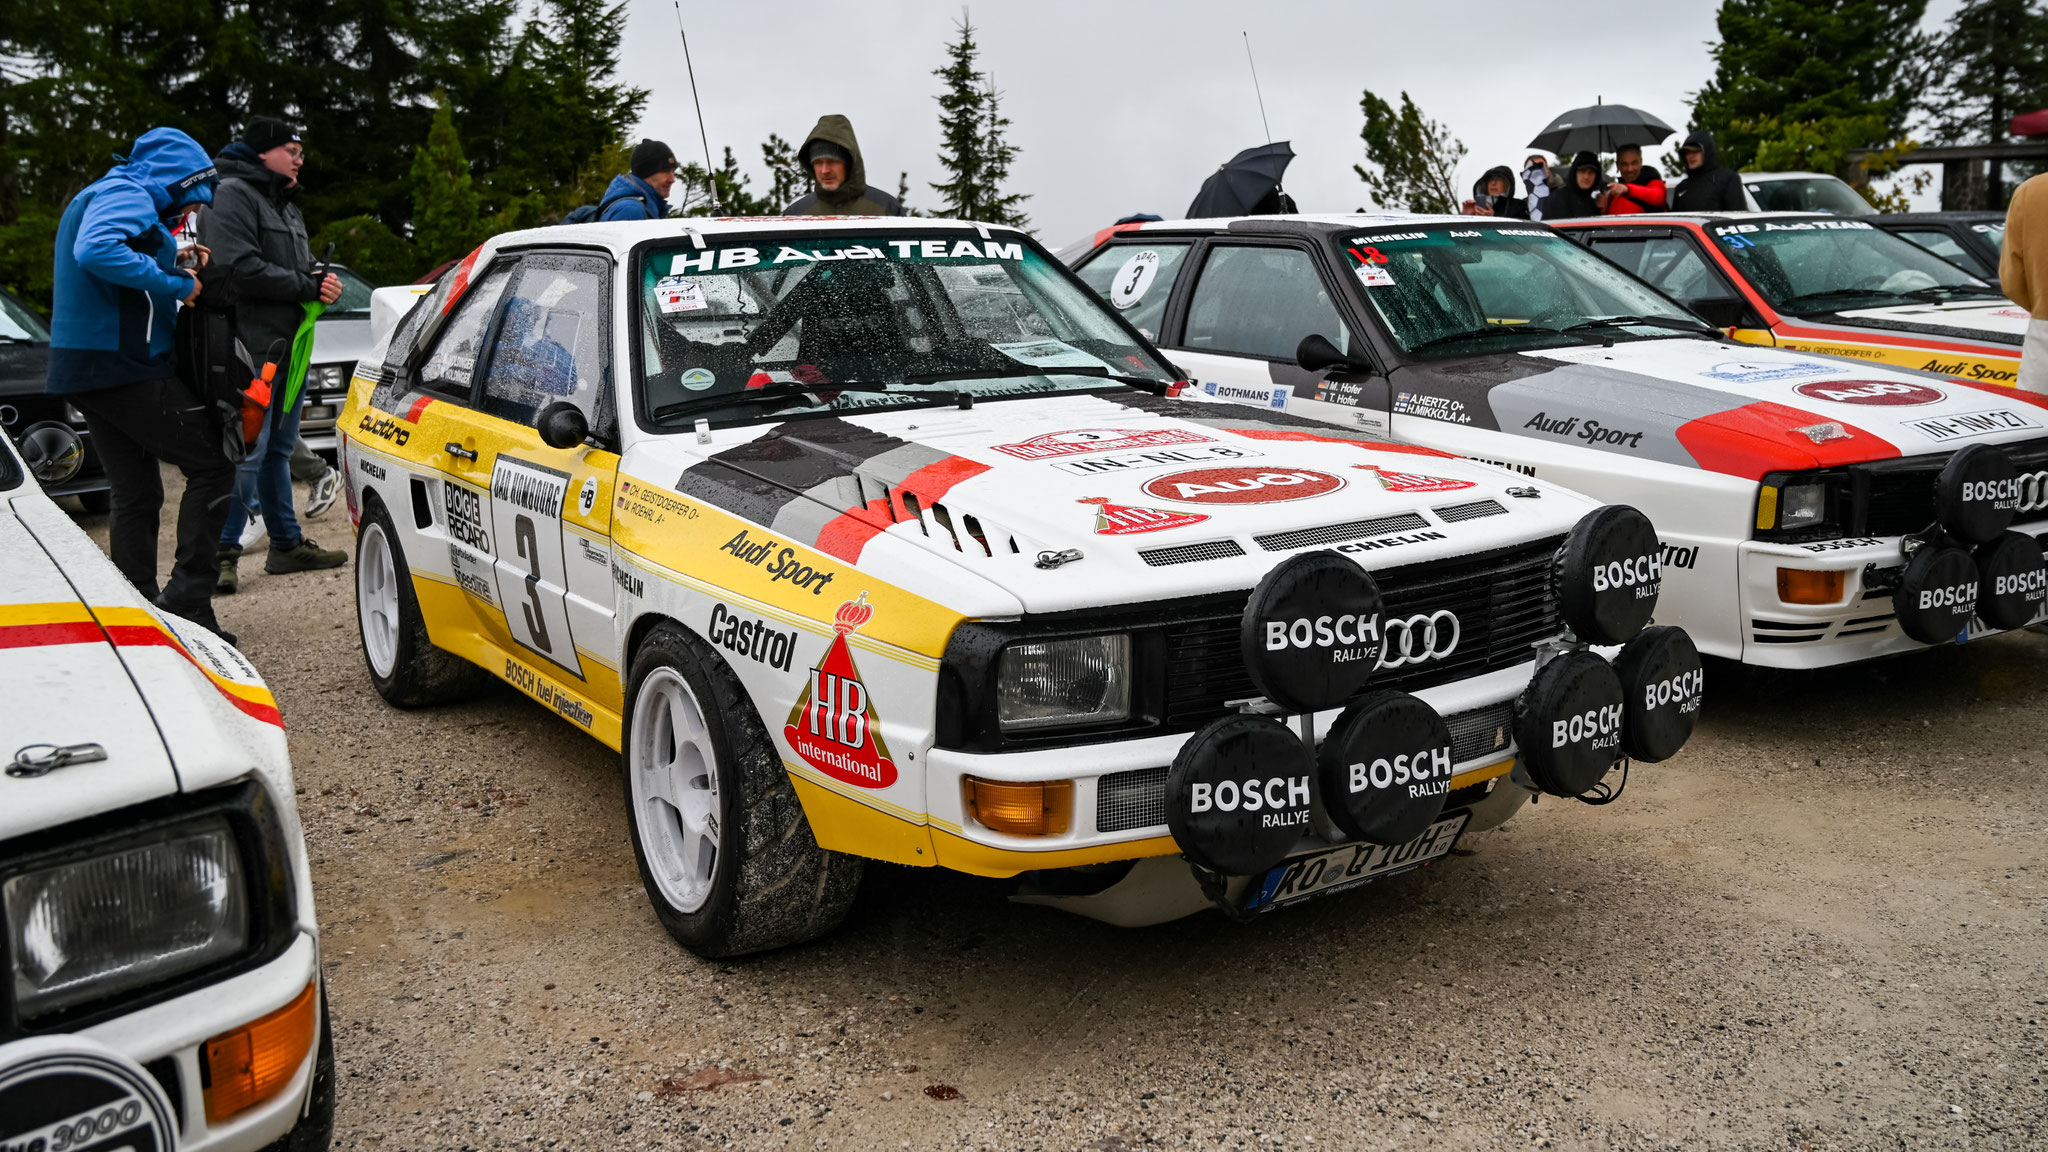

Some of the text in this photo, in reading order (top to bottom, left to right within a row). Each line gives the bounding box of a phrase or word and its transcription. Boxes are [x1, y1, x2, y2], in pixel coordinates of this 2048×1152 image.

[1351, 232, 1428, 245] MICHELIN
[1449, 230, 1482, 238] Audi
[1496, 229, 1558, 239] MICHELIN
[1715, 224, 1759, 236] HB
[1812, 221, 1874, 230] TEAM
[1722, 234, 1755, 249] 31
[669, 240, 1024, 276] HB Audi TEAM
[1135, 252, 1156, 263] ADAC
[1347, 246, 1388, 265] 18
[1123, 265, 1145, 295] 3
[1920, 360, 2017, 382] Audi Spor
[1217, 387, 1269, 401] ROTHMANS
[1329, 381, 1363, 395] M. Hofer
[1336, 394, 1359, 406] Hofer
[1814, 383, 1923, 401] Audi
[1406, 404, 1456, 422] H.MIKKOLA
[1410, 393, 1450, 409] A.HERTZ
[359, 415, 410, 446] quattro
[1523, 412, 1644, 448] Audi Sport
[360, 459, 387, 482] MICHELIN
[494, 467, 560, 519] BAD HOMBOURG
[1171, 470, 1319, 500] Audi
[1962, 478, 2018, 502] BOSCH
[445, 483, 481, 526] BOGE
[631, 502, 656, 522] ROEHRL
[640, 490, 690, 518] GEISTDOERFER
[1097, 507, 1171, 526] HB
[1993, 499, 2018, 510] RALLYE
[448, 514, 490, 554] RECARO
[1114, 517, 1198, 534] international
[1324, 531, 1448, 553] CHELIN
[1800, 537, 1884, 553] BOSCH
[720, 529, 834, 595] Audi Sport
[1660, 542, 1699, 569] trol
[515, 514, 552, 655] 3
[1593, 552, 1662, 592] BOSCH
[1995, 568, 2047, 595] BOSCH
[1919, 581, 1978, 609] BOSCH
[1952, 601, 1976, 615] RALLYE
[708, 603, 798, 673] Castrol
[1266, 613, 1379, 651] BOSCH
[1333, 646, 1378, 663] RALLYE
[505, 657, 594, 729] BOSCH fuel injection
[1645, 667, 1703, 711] BOSCH
[809, 666, 868, 749] HB
[1552, 703, 1623, 749] BOSCH
[797, 736, 882, 782] international
[1349, 746, 1451, 794] BOSCH
[1191, 775, 1310, 813] BOSCH
[1408, 780, 1451, 798] RALLYE
[1262, 809, 1310, 828] RALLYE
[1274, 857, 1328, 895] RO
[1346, 845, 1372, 877] Q
[51, 1099, 142, 1152] 3000
